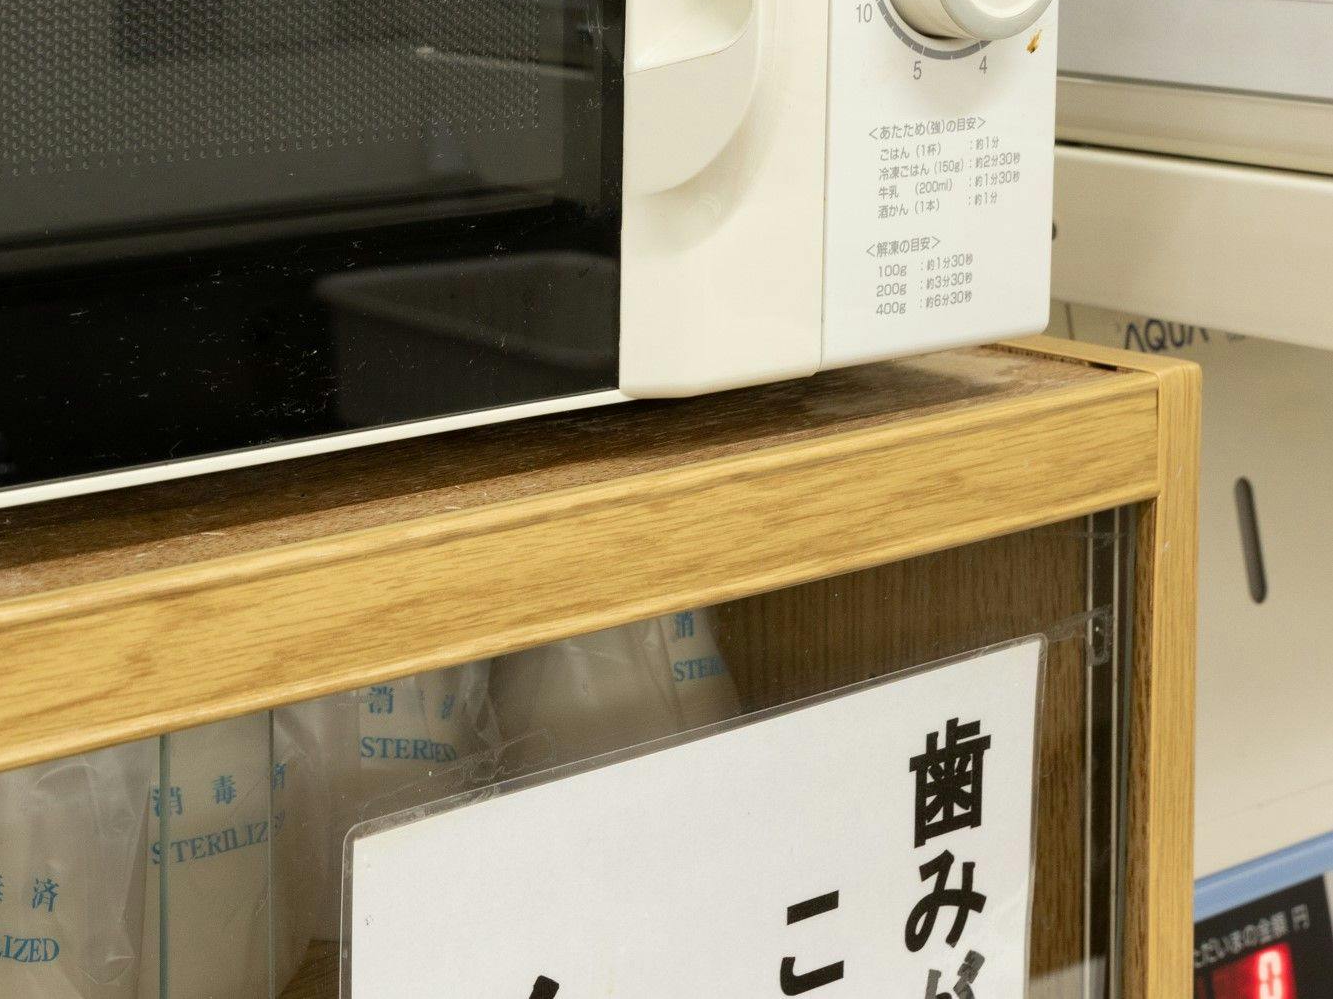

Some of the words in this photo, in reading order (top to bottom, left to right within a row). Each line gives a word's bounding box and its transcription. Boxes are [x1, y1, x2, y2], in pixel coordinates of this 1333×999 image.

[856, 4, 873, 23] 10
[913, 60, 922, 80] 5
[979, 56, 988, 75] 4
[878, 184, 899, 200] 牛乳
[878, 264, 907, 278] 100g
[876, 282, 907, 297] 200g
[876, 301, 907, 316] 400g
